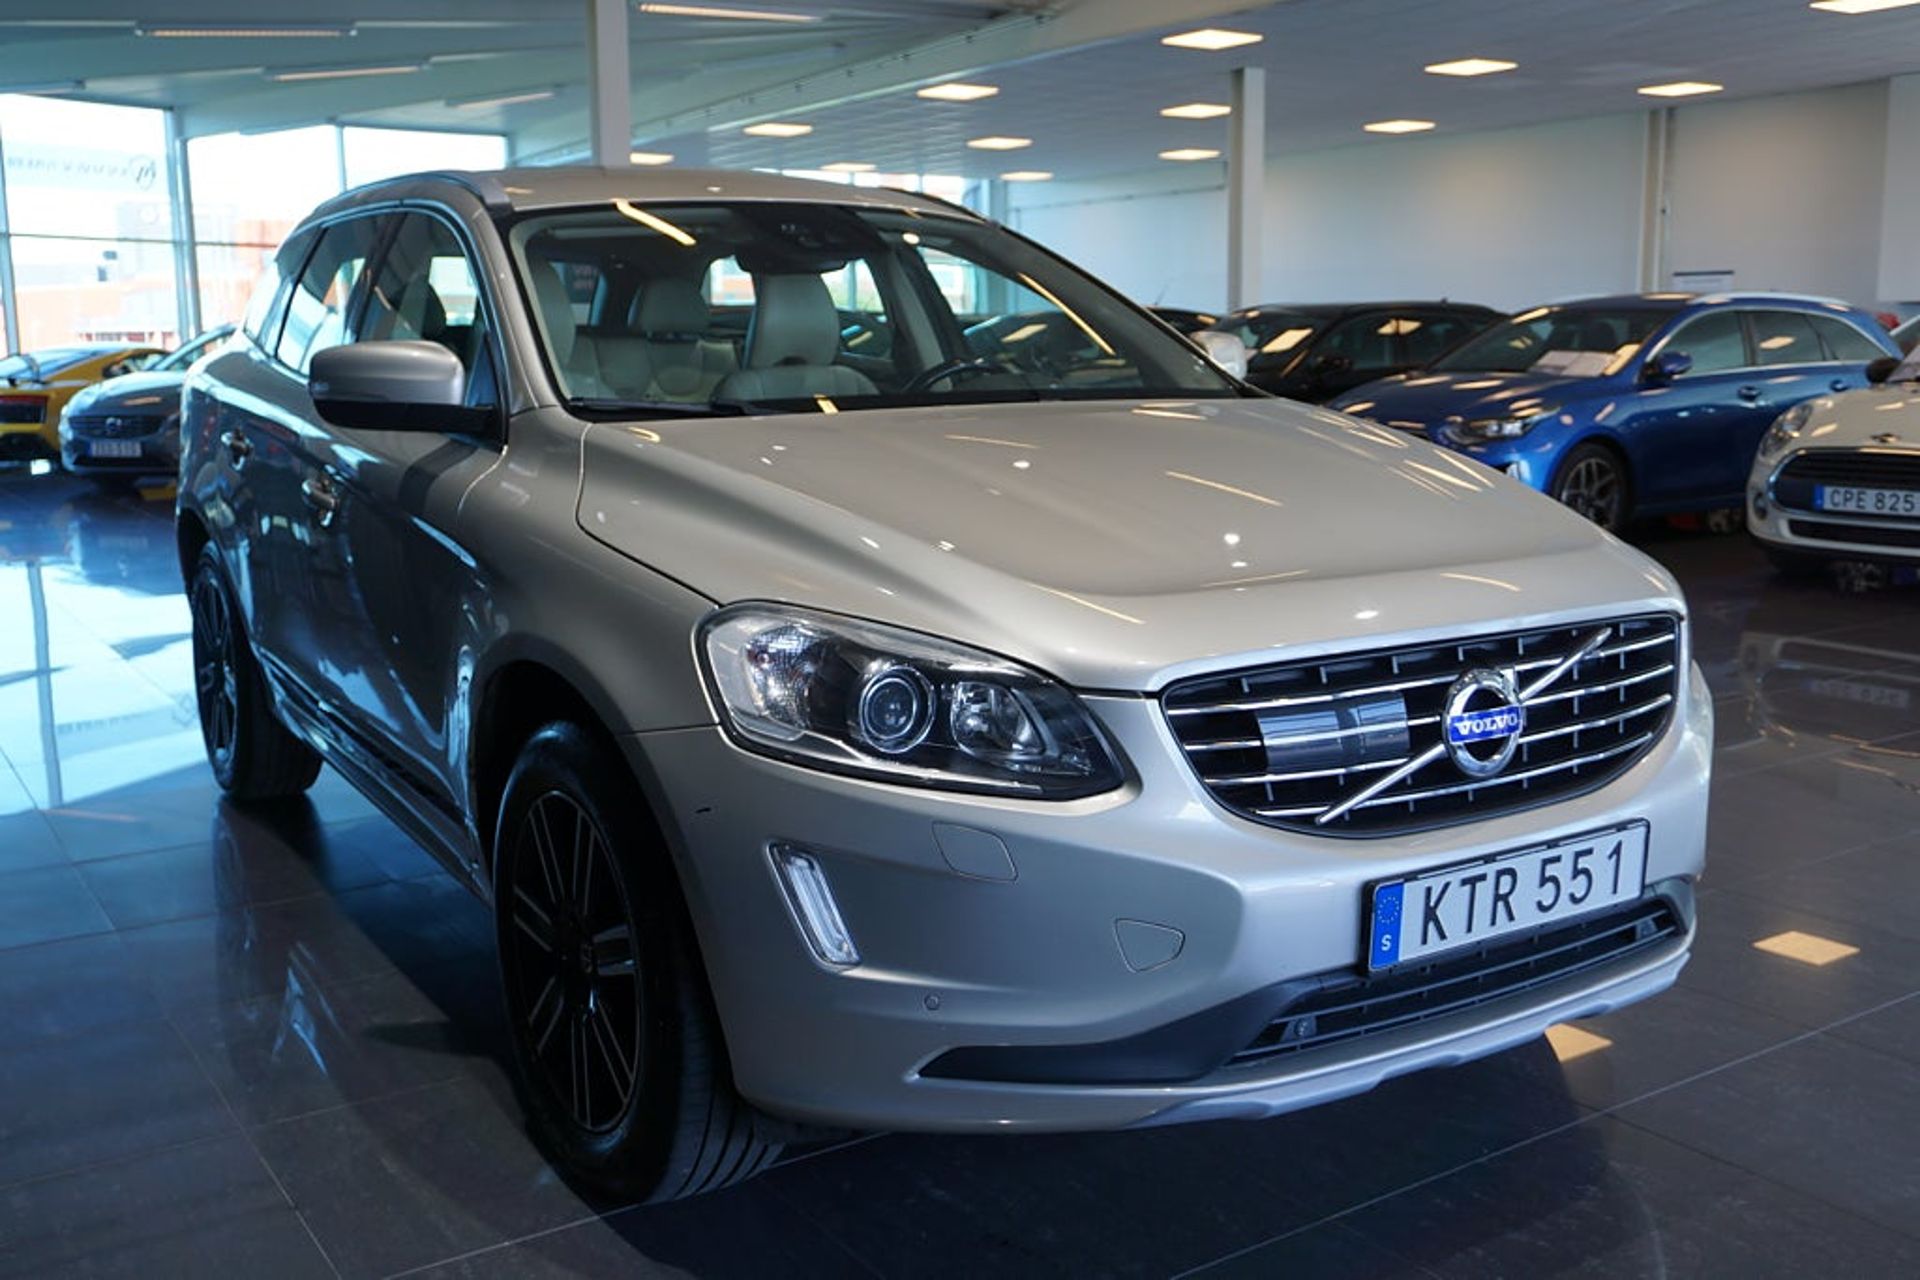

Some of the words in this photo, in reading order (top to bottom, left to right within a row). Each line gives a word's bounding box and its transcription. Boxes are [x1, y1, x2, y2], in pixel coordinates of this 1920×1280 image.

[1830, 488, 1867, 510] CPE
[1874, 492, 1915, 513] 825
[1454, 713, 1518, 736] VOLVO
[1420, 866, 1518, 946] KTR
[1535, 839, 1623, 914] 551
[1381, 934, 1392, 951] S
